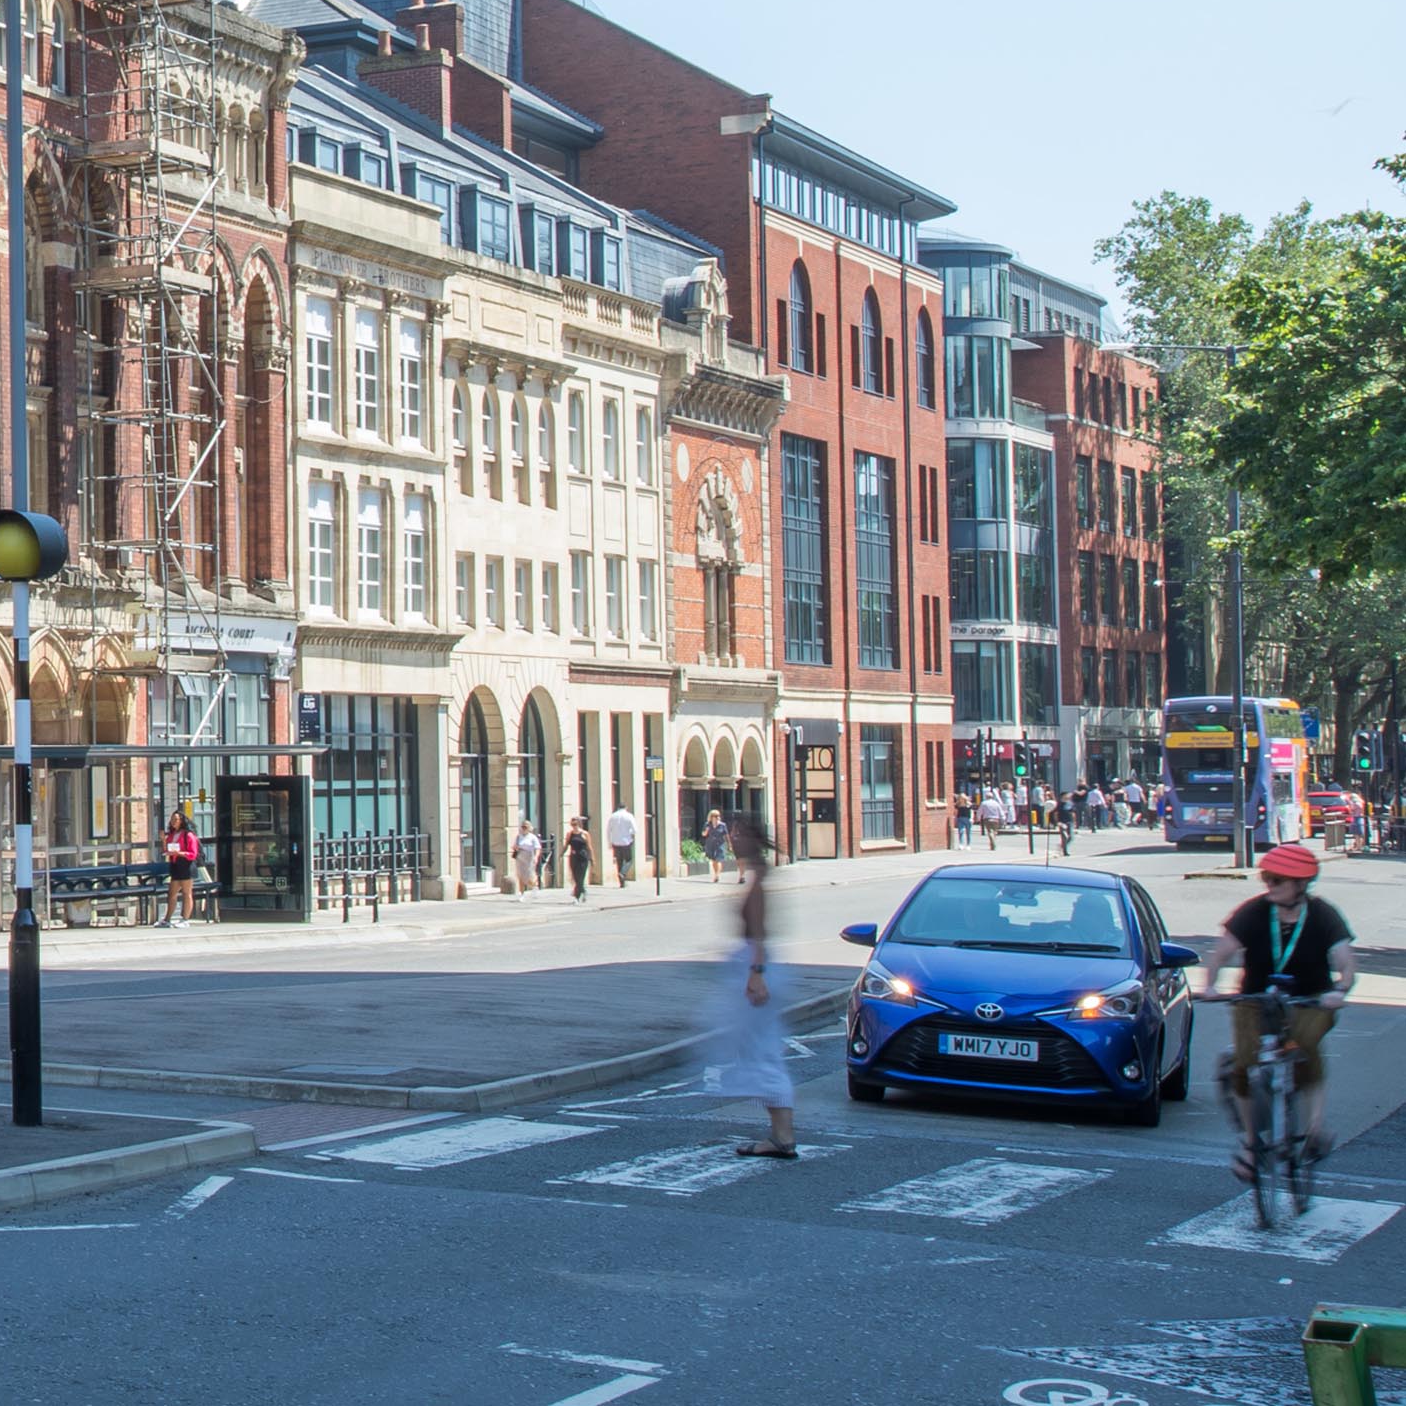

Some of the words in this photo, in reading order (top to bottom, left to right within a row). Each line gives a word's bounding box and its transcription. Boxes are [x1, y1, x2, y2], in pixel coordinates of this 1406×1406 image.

[186, 625, 224, 637] VICTORA
[228, 628, 255, 639] COURT
[971, 626, 1006, 636] paragon
[953, 1037, 992, 1054] WM17
[996, 1040, 1031, 1058] YJO
